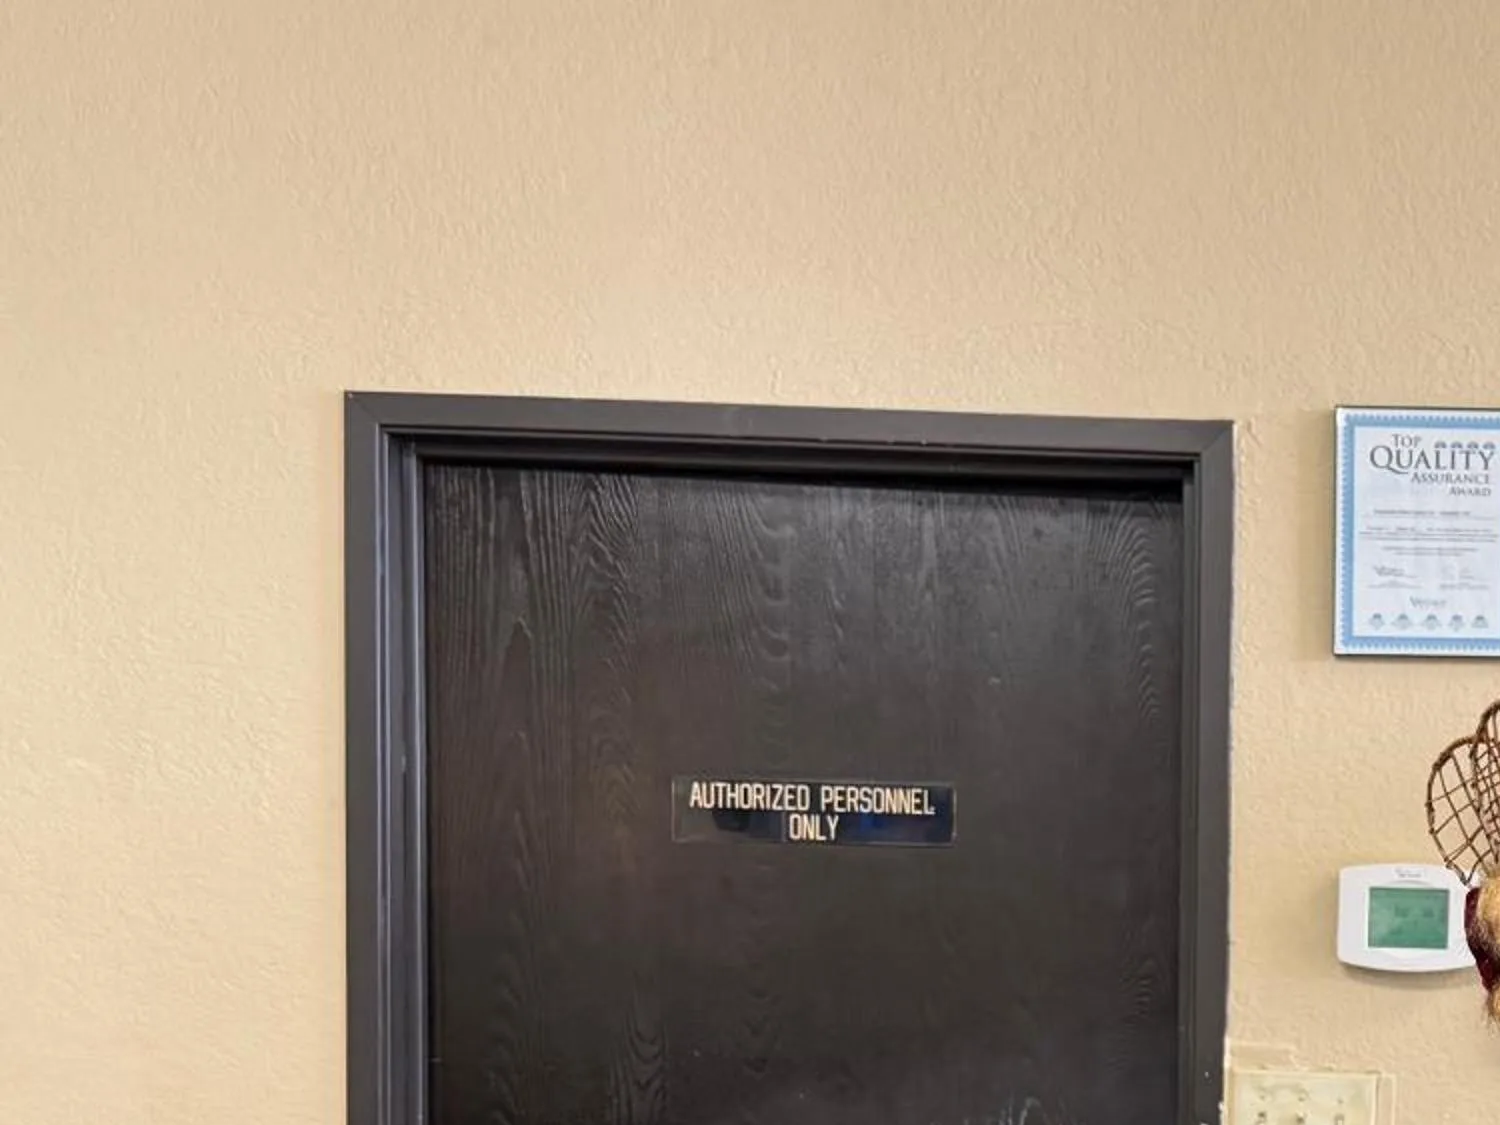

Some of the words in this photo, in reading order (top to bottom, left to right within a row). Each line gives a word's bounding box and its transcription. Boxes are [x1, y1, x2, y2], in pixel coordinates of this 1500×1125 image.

[1392, 433, 1422, 448] TOP
[1369, 445, 1495, 475] QUALITY
[1411, 472, 1490, 485] ASSURANCE
[688, 781, 810, 811] AUTHORIZED
[820, 785, 936, 815] PERSONNEL
[788, 812, 840, 841] ONLY
